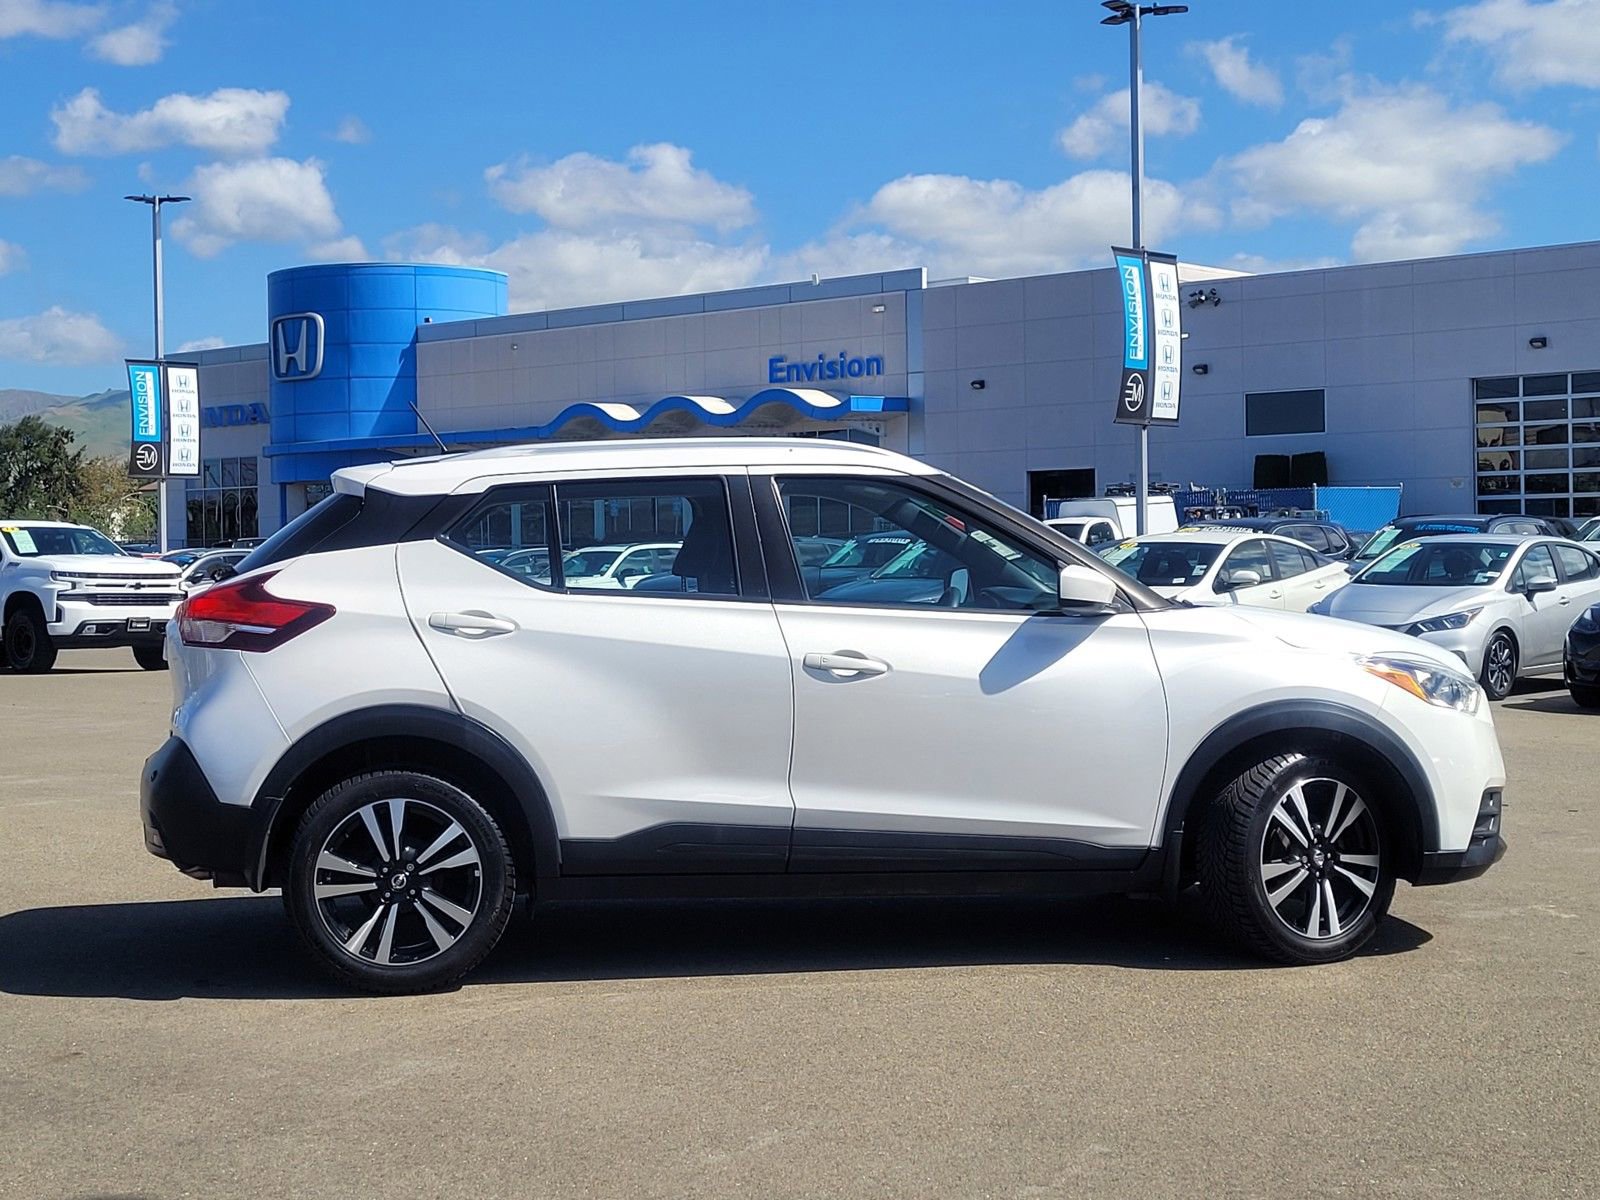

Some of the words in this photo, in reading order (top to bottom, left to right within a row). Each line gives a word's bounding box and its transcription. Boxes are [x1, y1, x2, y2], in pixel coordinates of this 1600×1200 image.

[1124, 266, 1139, 359] ENVISION
[768, 351, 884, 384] Envision
[135, 370, 149, 436] ENVISION
